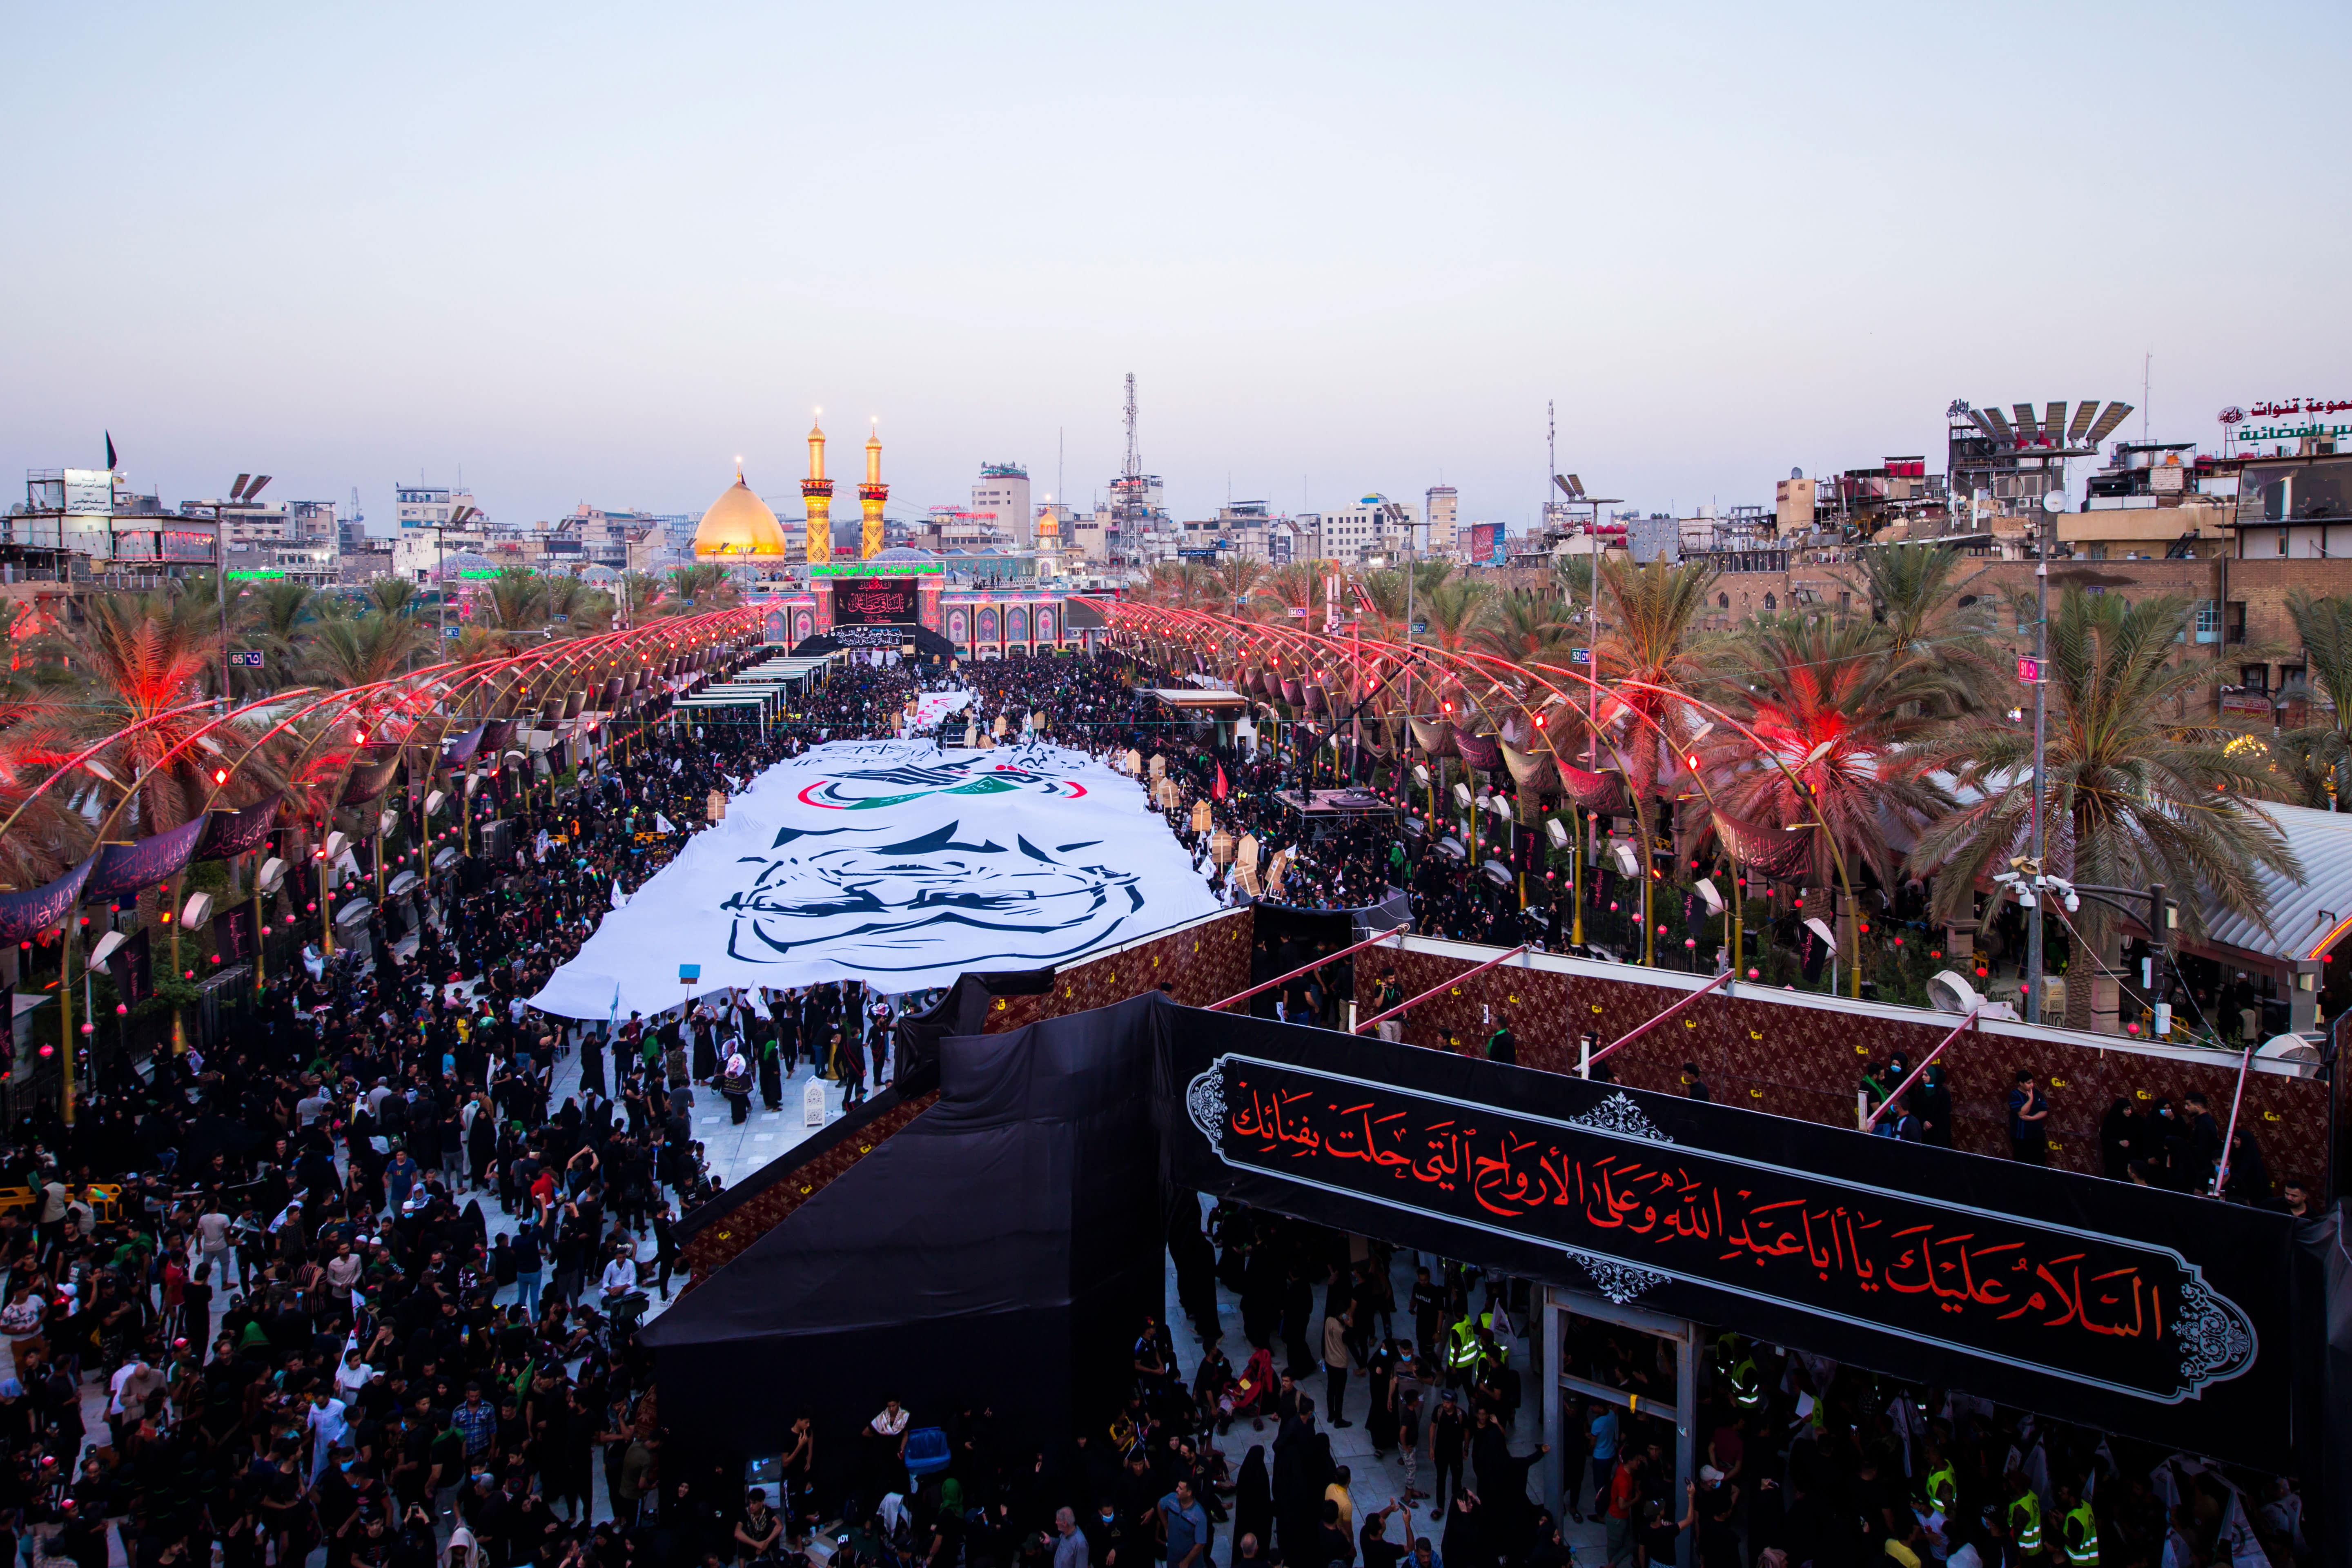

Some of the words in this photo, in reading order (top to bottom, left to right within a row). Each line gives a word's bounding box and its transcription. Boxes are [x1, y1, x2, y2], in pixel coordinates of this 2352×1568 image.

[2251, 398, 2300, 418] قنوات
[888, 565, 912, 574] عليك
[914, 564, 942, 575] السلام
[232, 654, 243, 664] 65
[246, 654, 259, 664] ٦٥
[1573, 652, 1580, 660] 52
[2021, 662, 2027, 676] 51
[1232, 1082, 1320, 1157] بفنائك
[1325, 1102, 1412, 1179] حلت
[1475, 1130, 1583, 1216] الأرواح
[1587, 1156, 1658, 1234] وعلى
[1650, 1168, 1722, 1243] الله
[1719, 1190, 1806, 1267] عبد
[1803, 1206, 1847, 1281] أبا
[1846, 1211, 1882, 1292] يا
[1886, 1225, 2025, 1313] عليك
[1997, 1254, 2162, 1341] السلام
